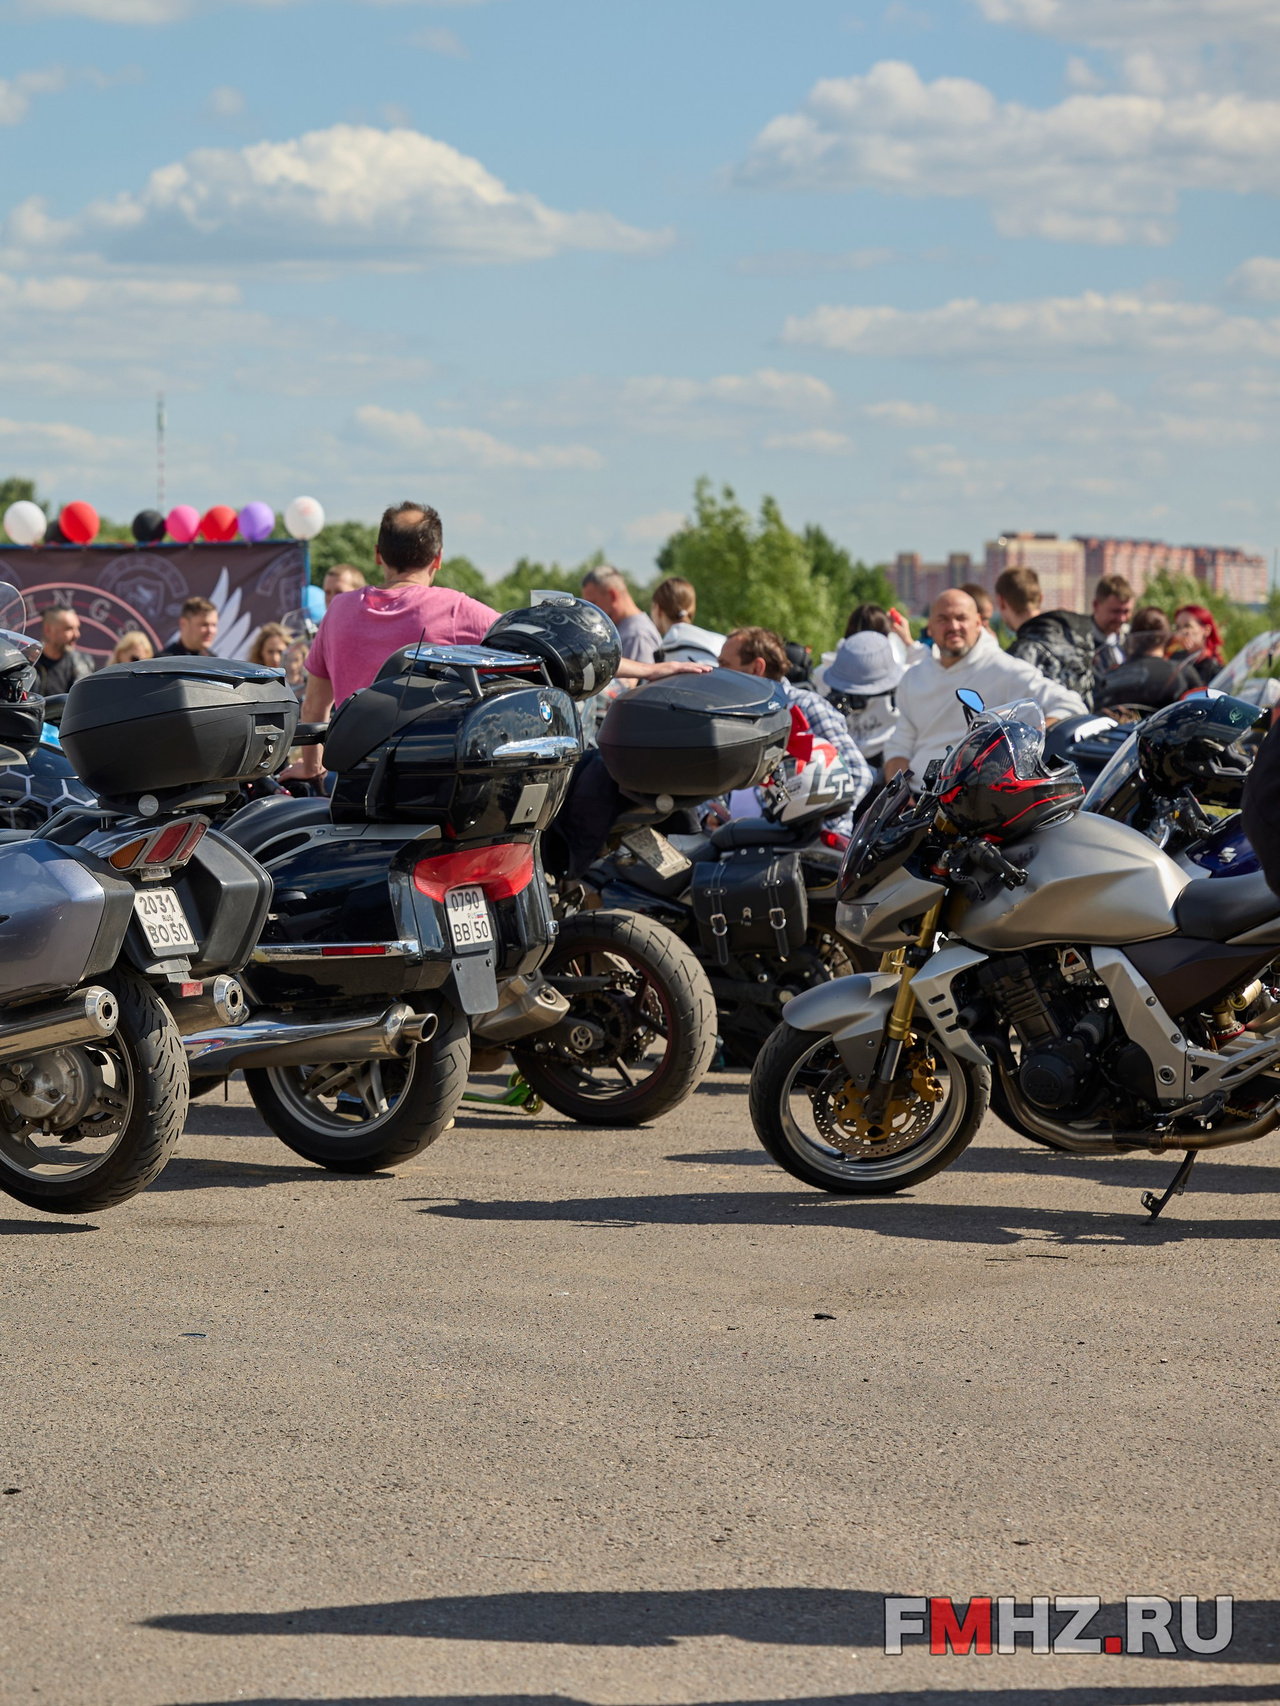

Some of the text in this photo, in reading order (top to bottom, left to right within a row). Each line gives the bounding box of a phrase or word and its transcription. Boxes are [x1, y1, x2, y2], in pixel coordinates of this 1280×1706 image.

[139, 894, 175, 915] 2031
[451, 890, 480, 912] 0790
[170, 922, 188, 942] 50
[474, 921, 488, 939] 50
